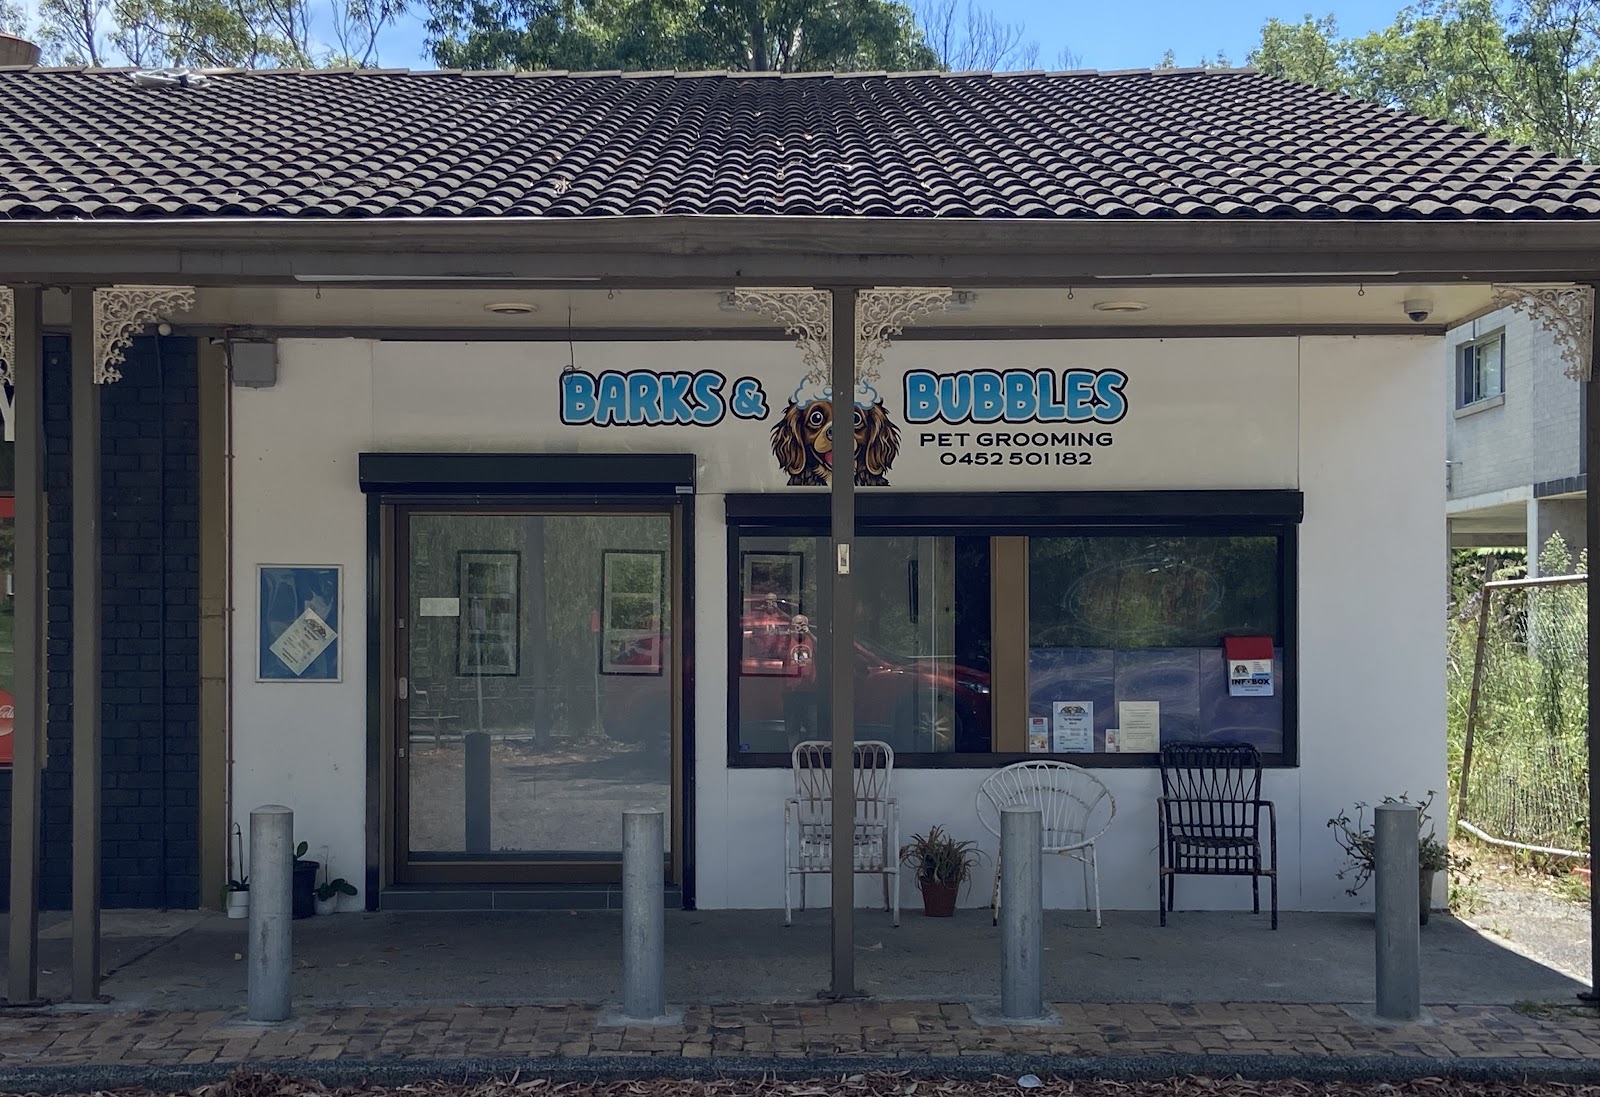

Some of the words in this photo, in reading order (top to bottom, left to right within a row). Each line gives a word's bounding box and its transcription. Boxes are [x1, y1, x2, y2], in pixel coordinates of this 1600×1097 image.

[559, 369, 727, 427] BARKS
[729, 376, 770, 420] &
[903, 368, 1129, 425] BUBBLES
[919, 432, 970, 447] PET
[976, 432, 1113, 447] GROOMING
[939, 452, 1004, 466] 0452
